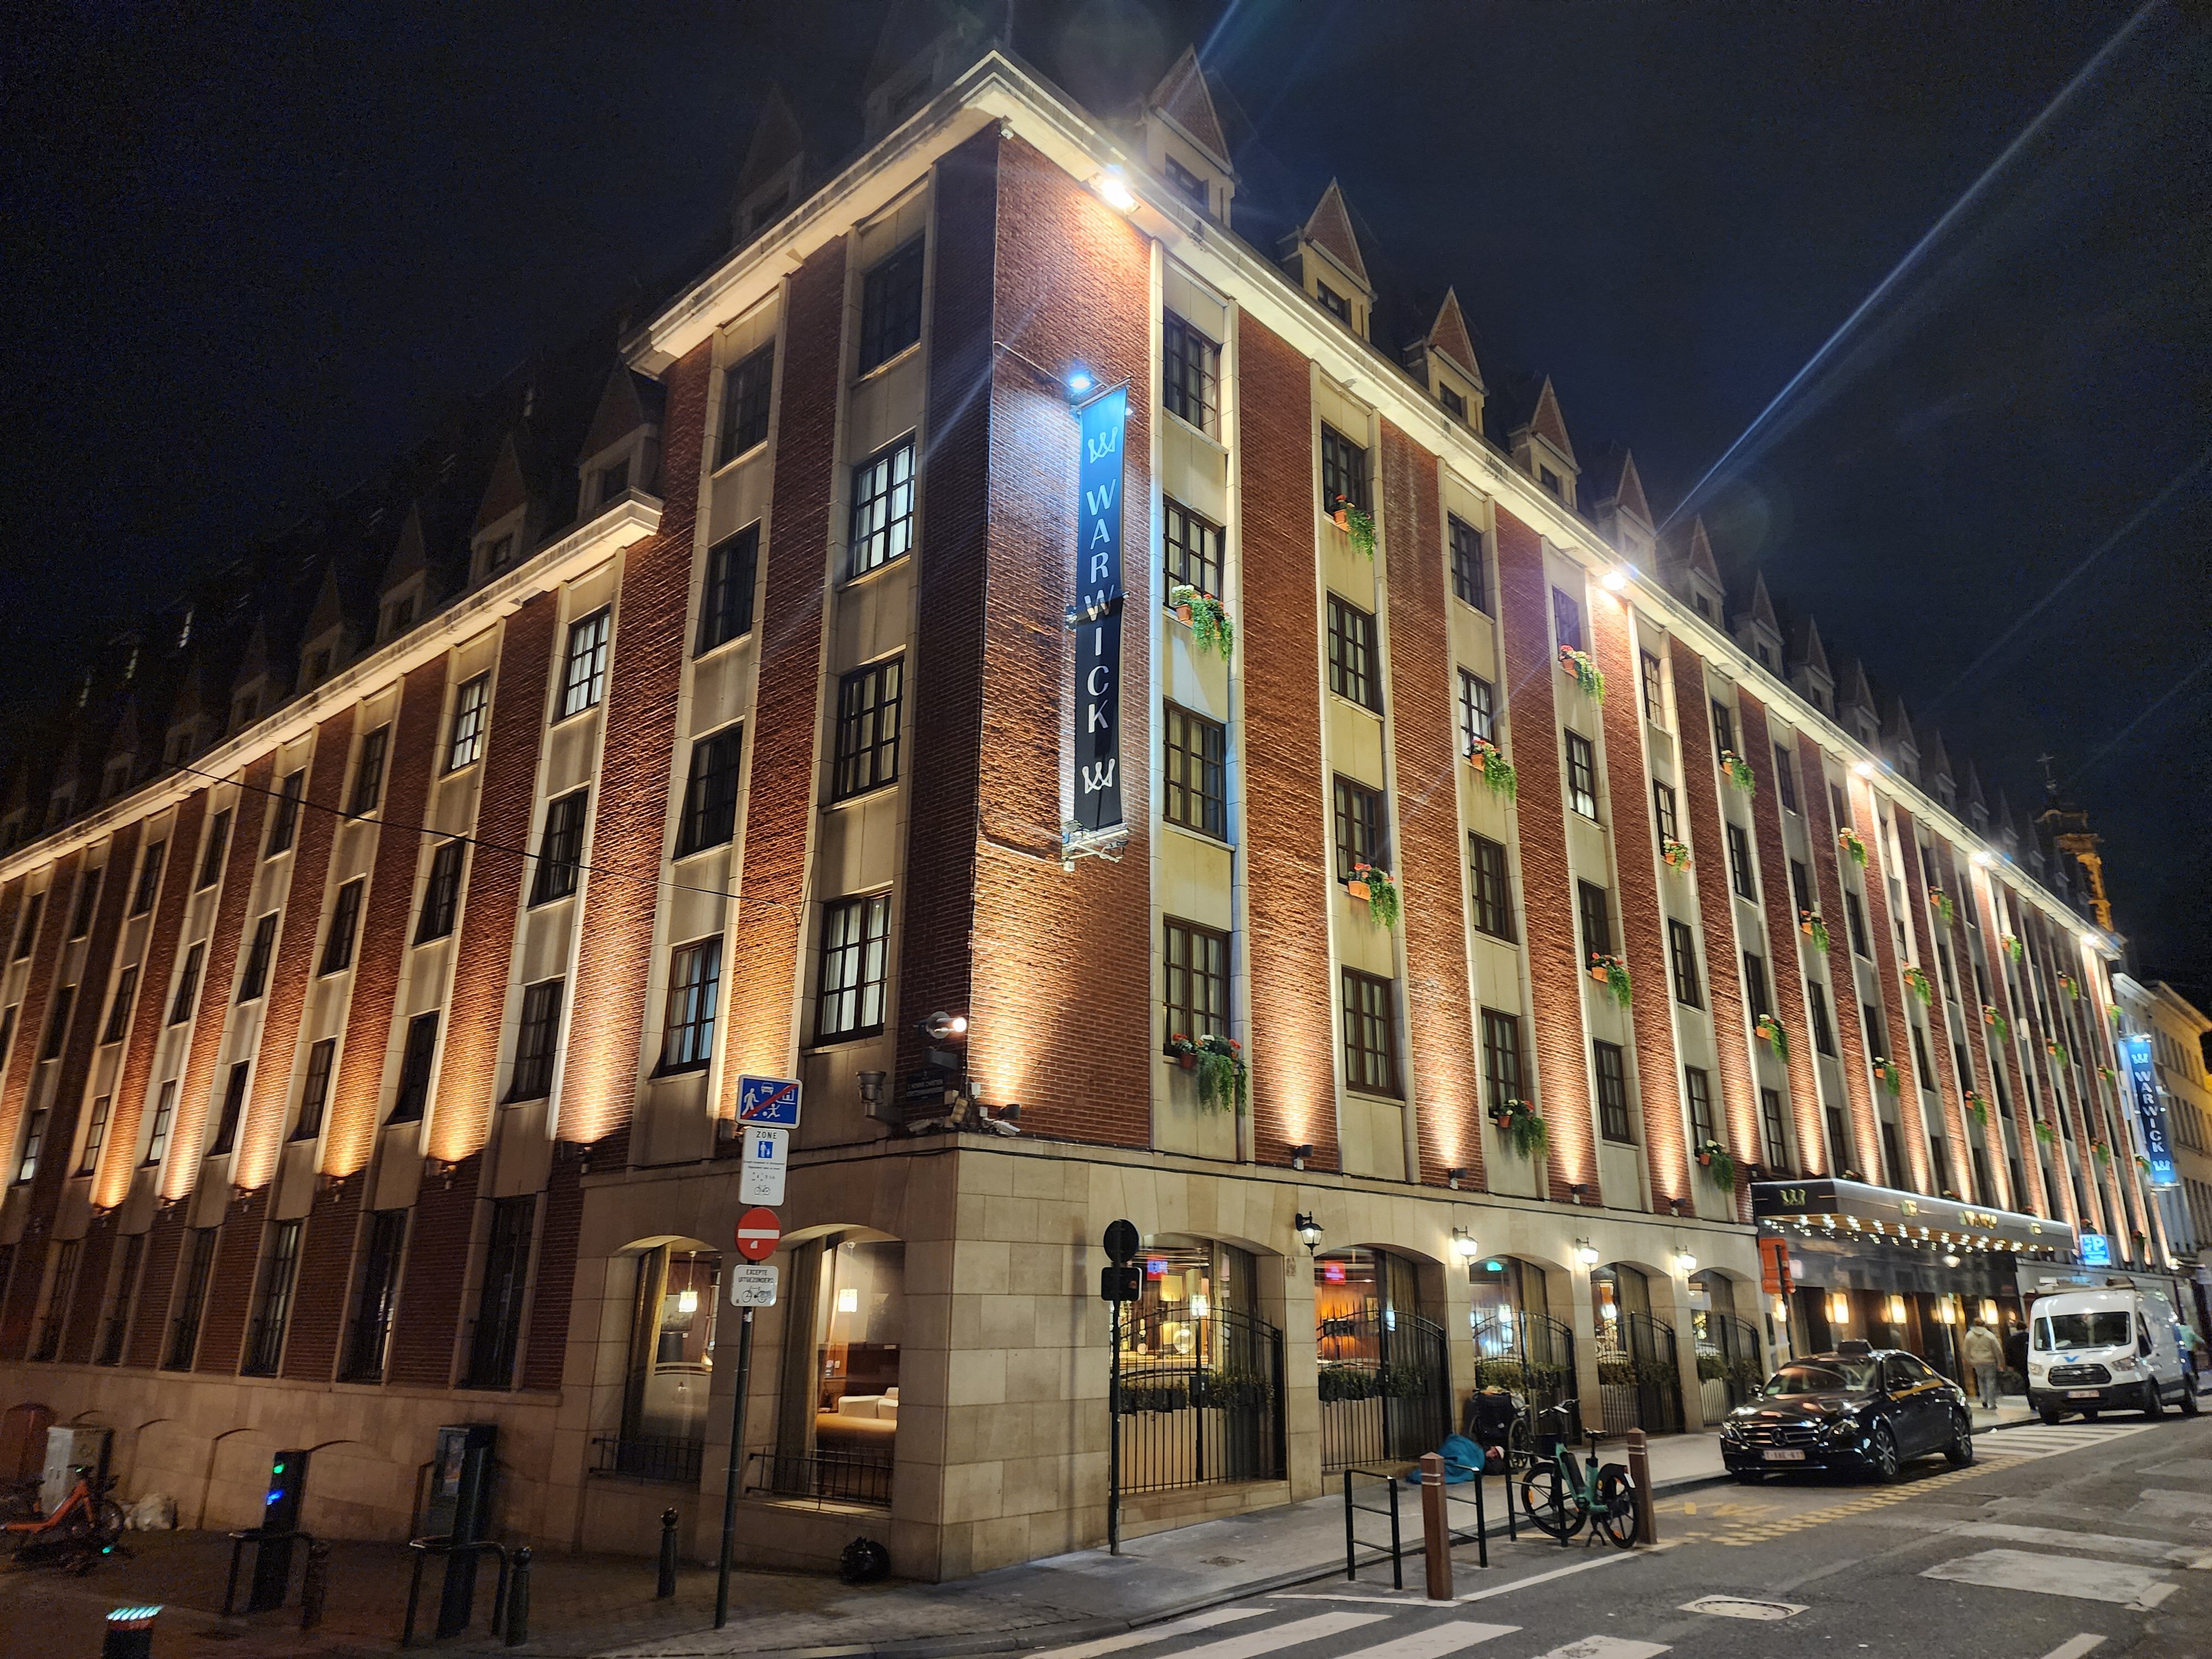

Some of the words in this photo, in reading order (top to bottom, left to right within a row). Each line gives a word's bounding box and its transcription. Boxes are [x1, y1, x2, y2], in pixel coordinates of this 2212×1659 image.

[1084, 478, 1116, 733] WARWICK
[756, 1131, 778, 1139] ZONE
[2135, 1071, 2164, 1153] WARWICK
